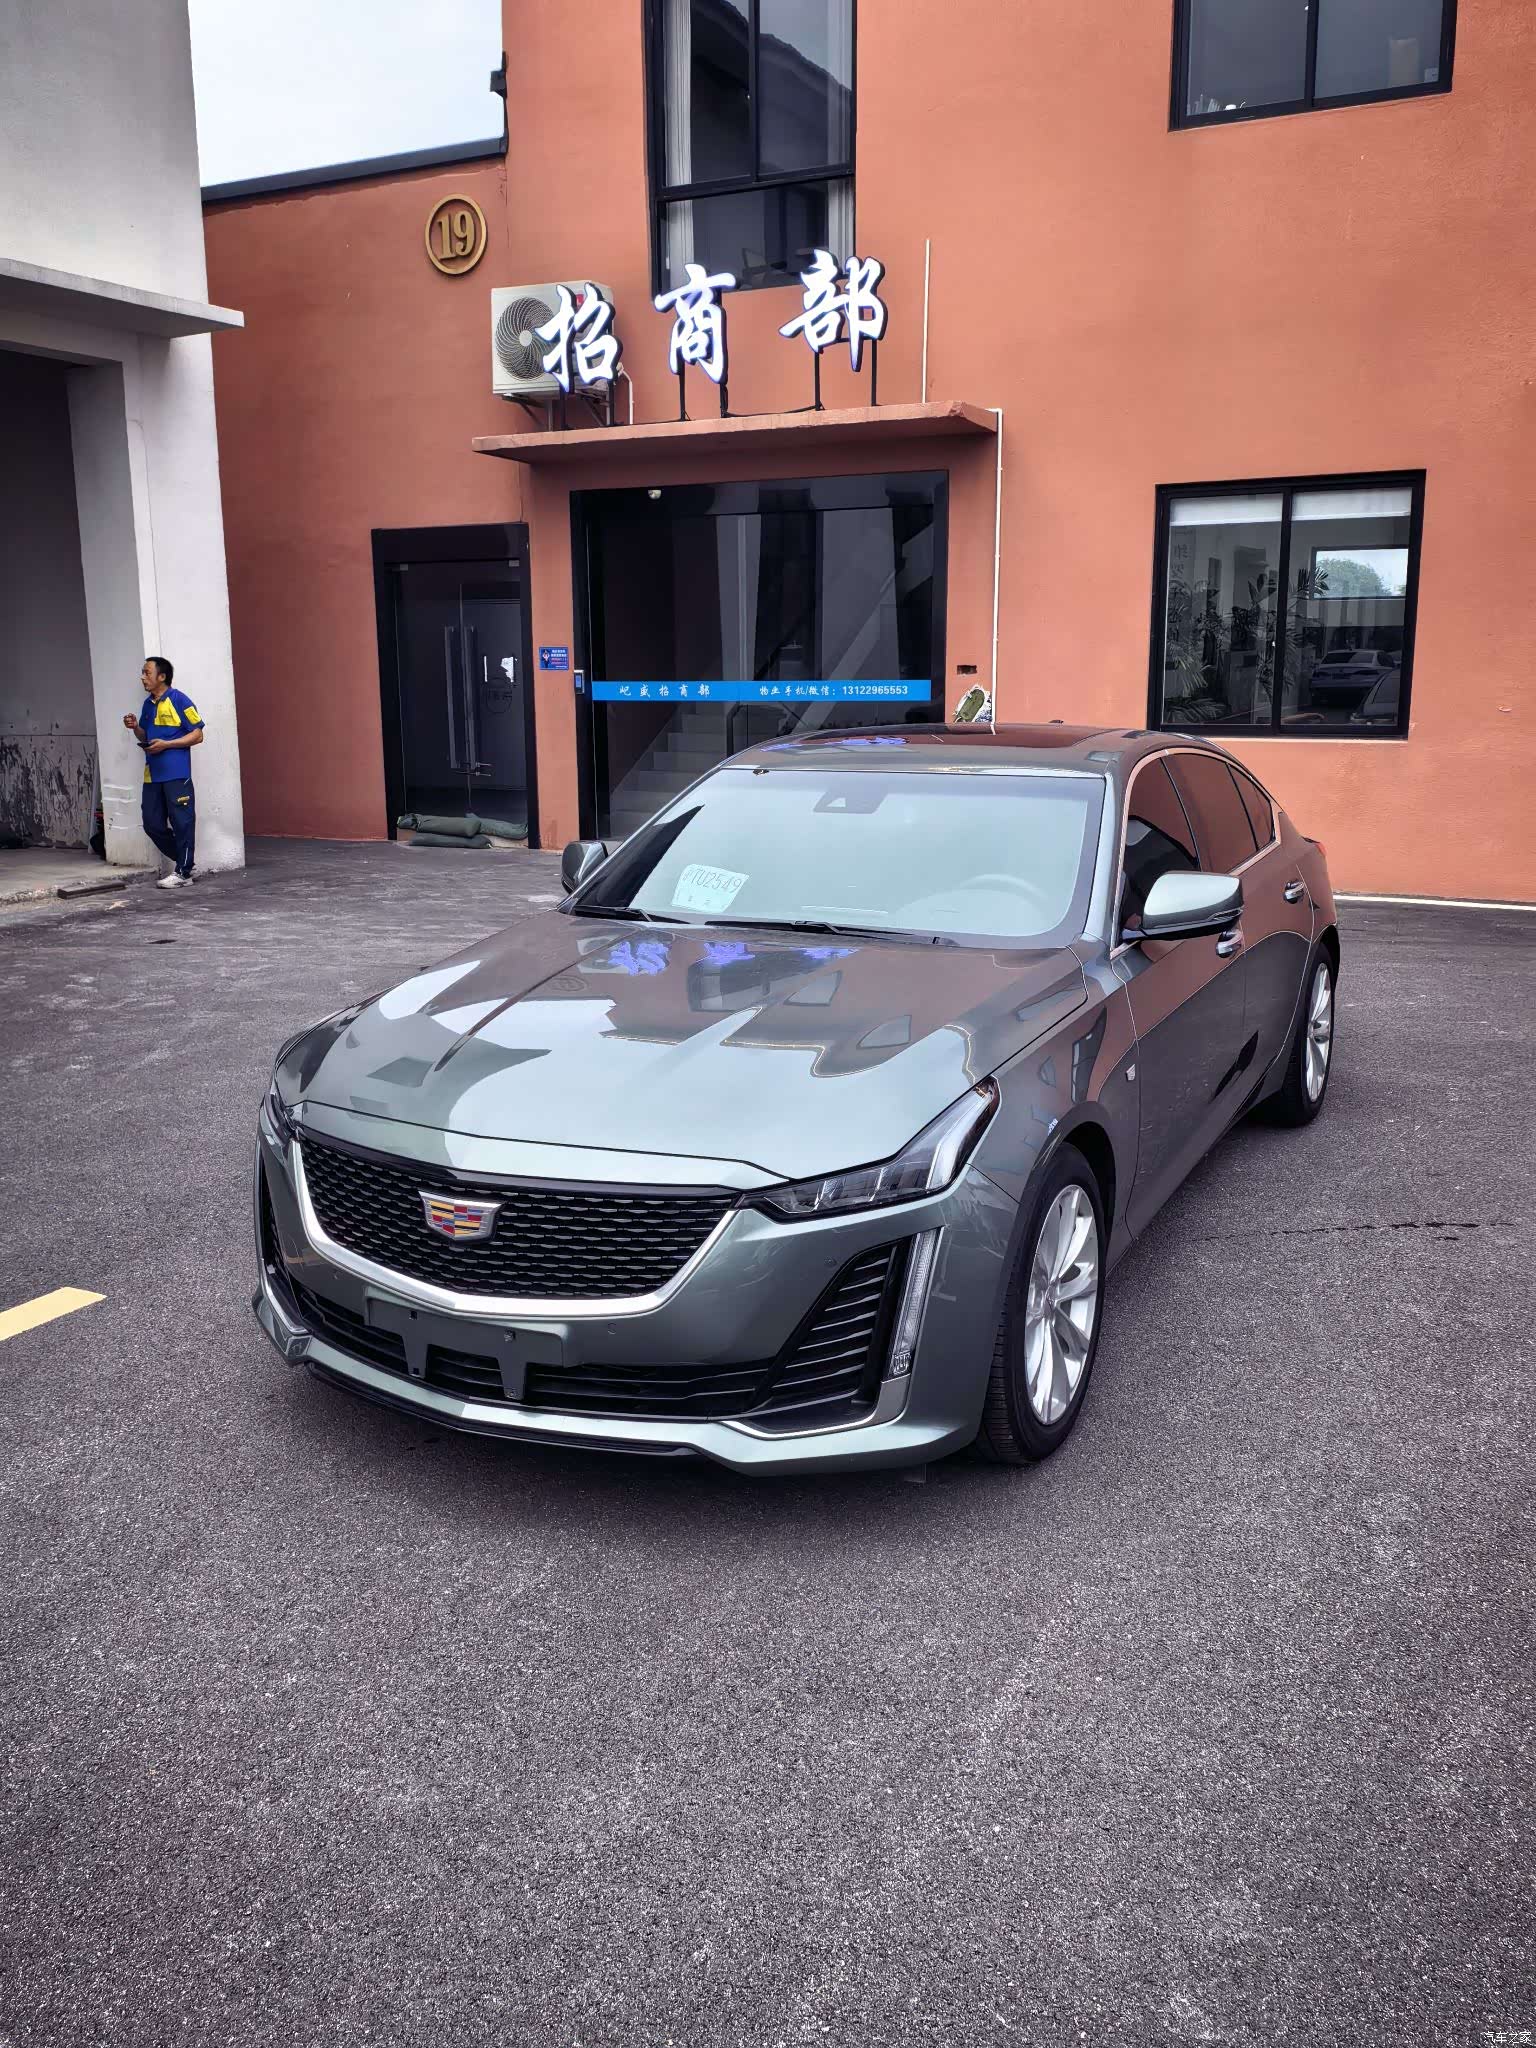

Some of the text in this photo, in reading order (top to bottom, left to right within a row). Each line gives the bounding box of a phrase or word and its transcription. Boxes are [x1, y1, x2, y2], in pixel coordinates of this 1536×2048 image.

[437, 209, 475, 262] 19
[535, 249, 887, 393] 招商部
